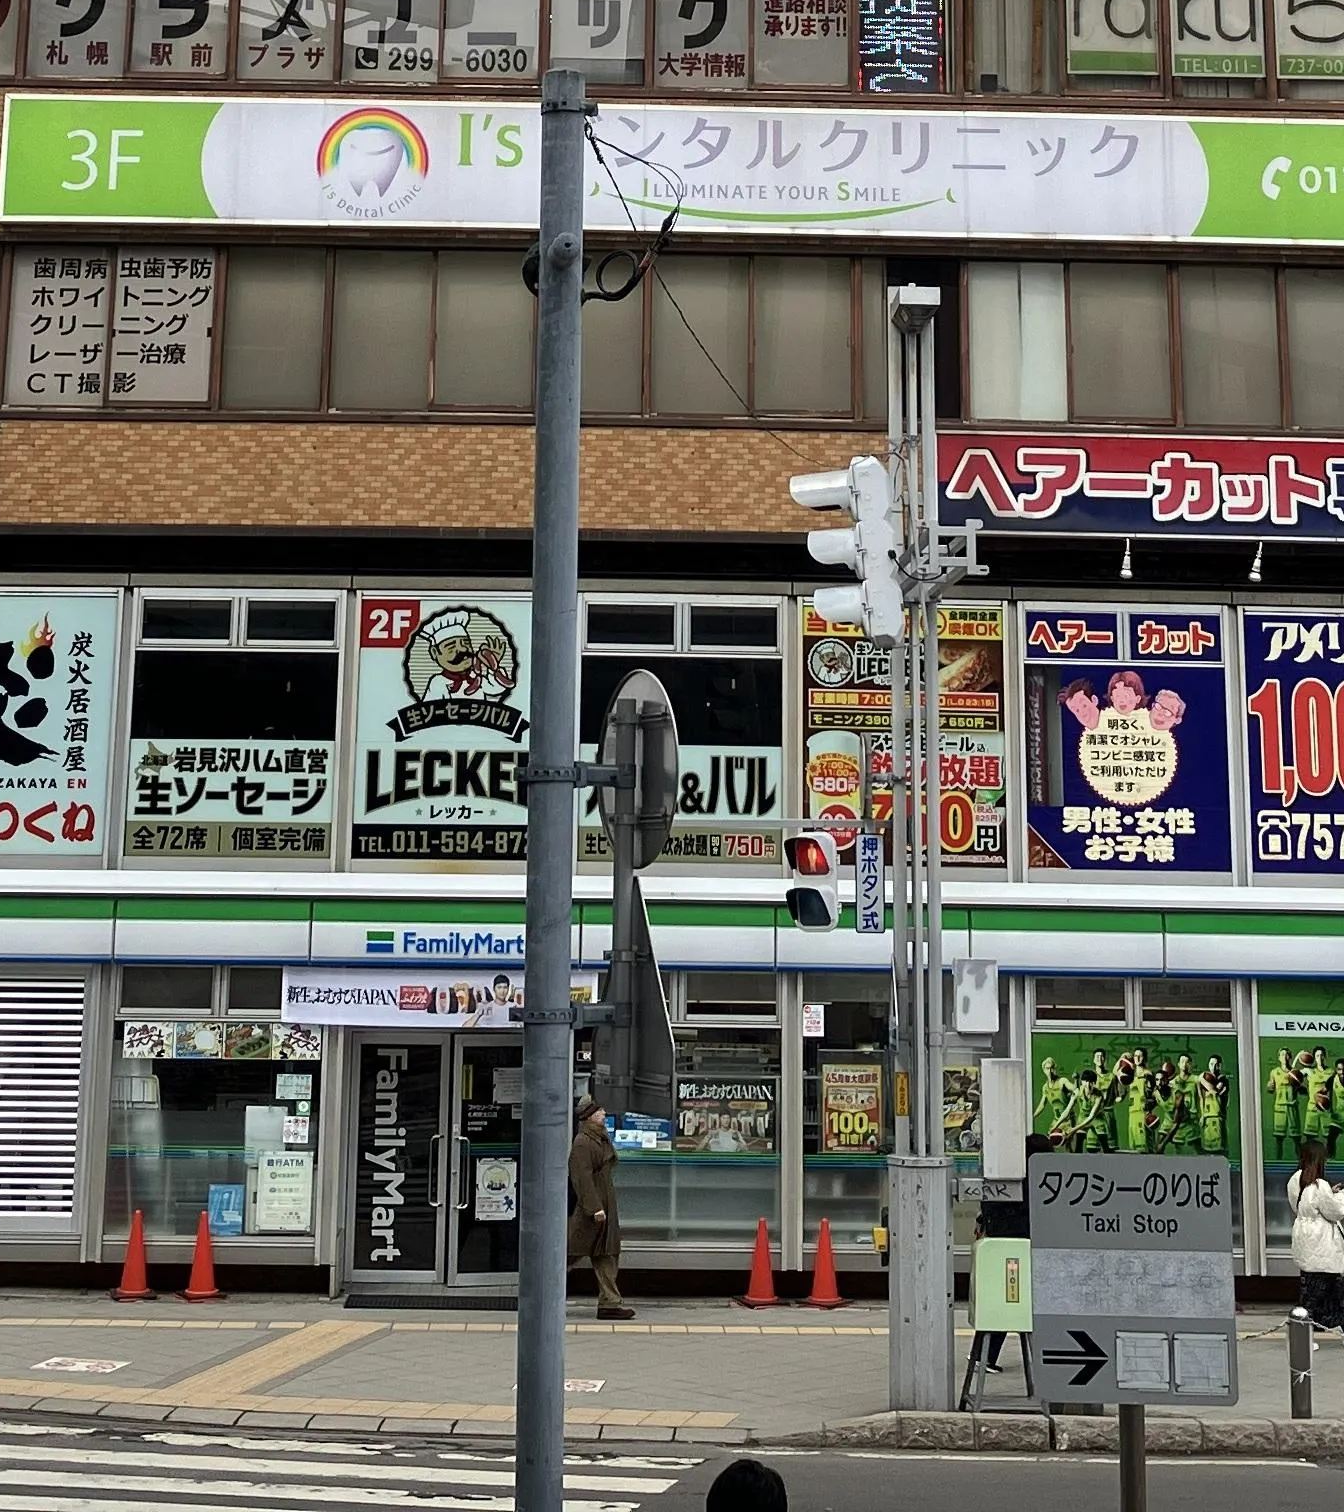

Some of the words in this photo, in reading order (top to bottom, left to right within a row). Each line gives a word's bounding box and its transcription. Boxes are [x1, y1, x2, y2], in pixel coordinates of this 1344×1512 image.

[658, 51, 746, 79] 大学情報
[60, 128, 145, 192] 3F
[598, 117, 1140, 179] ンタルクリニック
[337, 199, 384, 219] Dental
[389, 183, 423, 217] Clinic
[775, 184, 829, 202] YOUR
[34, 257, 109, 280] 歯周病
[120, 257, 213, 280] 虫歯予防
[31, 285, 213, 308] ホワイトニング
[30, 313, 190, 336] クリーニング
[29, 342, 187, 366] レーザー治療
[368, 608, 413, 639] 2F
[948, 622, 1001, 638] 喫煙OK
[1029, 619, 1114, 654] ヘアー
[1137, 620, 1215, 655] カット
[62, 631, 95, 772] 炭火居酒屋
[406, 701, 512, 730] 生ソーセージバル
[173, 746, 329, 775] 岩見沢ハム直営
[1089, 749, 1167, 763] コンビニ感覚で
[67, 778, 87, 789] EN
[363, 749, 529, 816] LECKE
[1089, 764, 1168, 778] ご利用いただけ
[133, 775, 328, 816] 生ソーセージ
[429, 804, 484, 820] レッカー
[1062, 806, 1197, 835] 男性・女性
[131, 825, 208, 852] 全72席
[230, 827, 326, 852] 個室完備
[359, 830, 528, 855] TEL.011-594-87
[1084, 833, 1176, 863] お子様
[861, 837, 880, 930] 押ボタン式
[403, 932, 525, 956] FamilyMart
[364, 1048, 409, 1262] FamilyMart
[1038, 1171, 1221, 1209] タクシーのりば
[1081, 1213, 1121, 1234] Taxi
[1133, 1214, 1179, 1238] Stop
